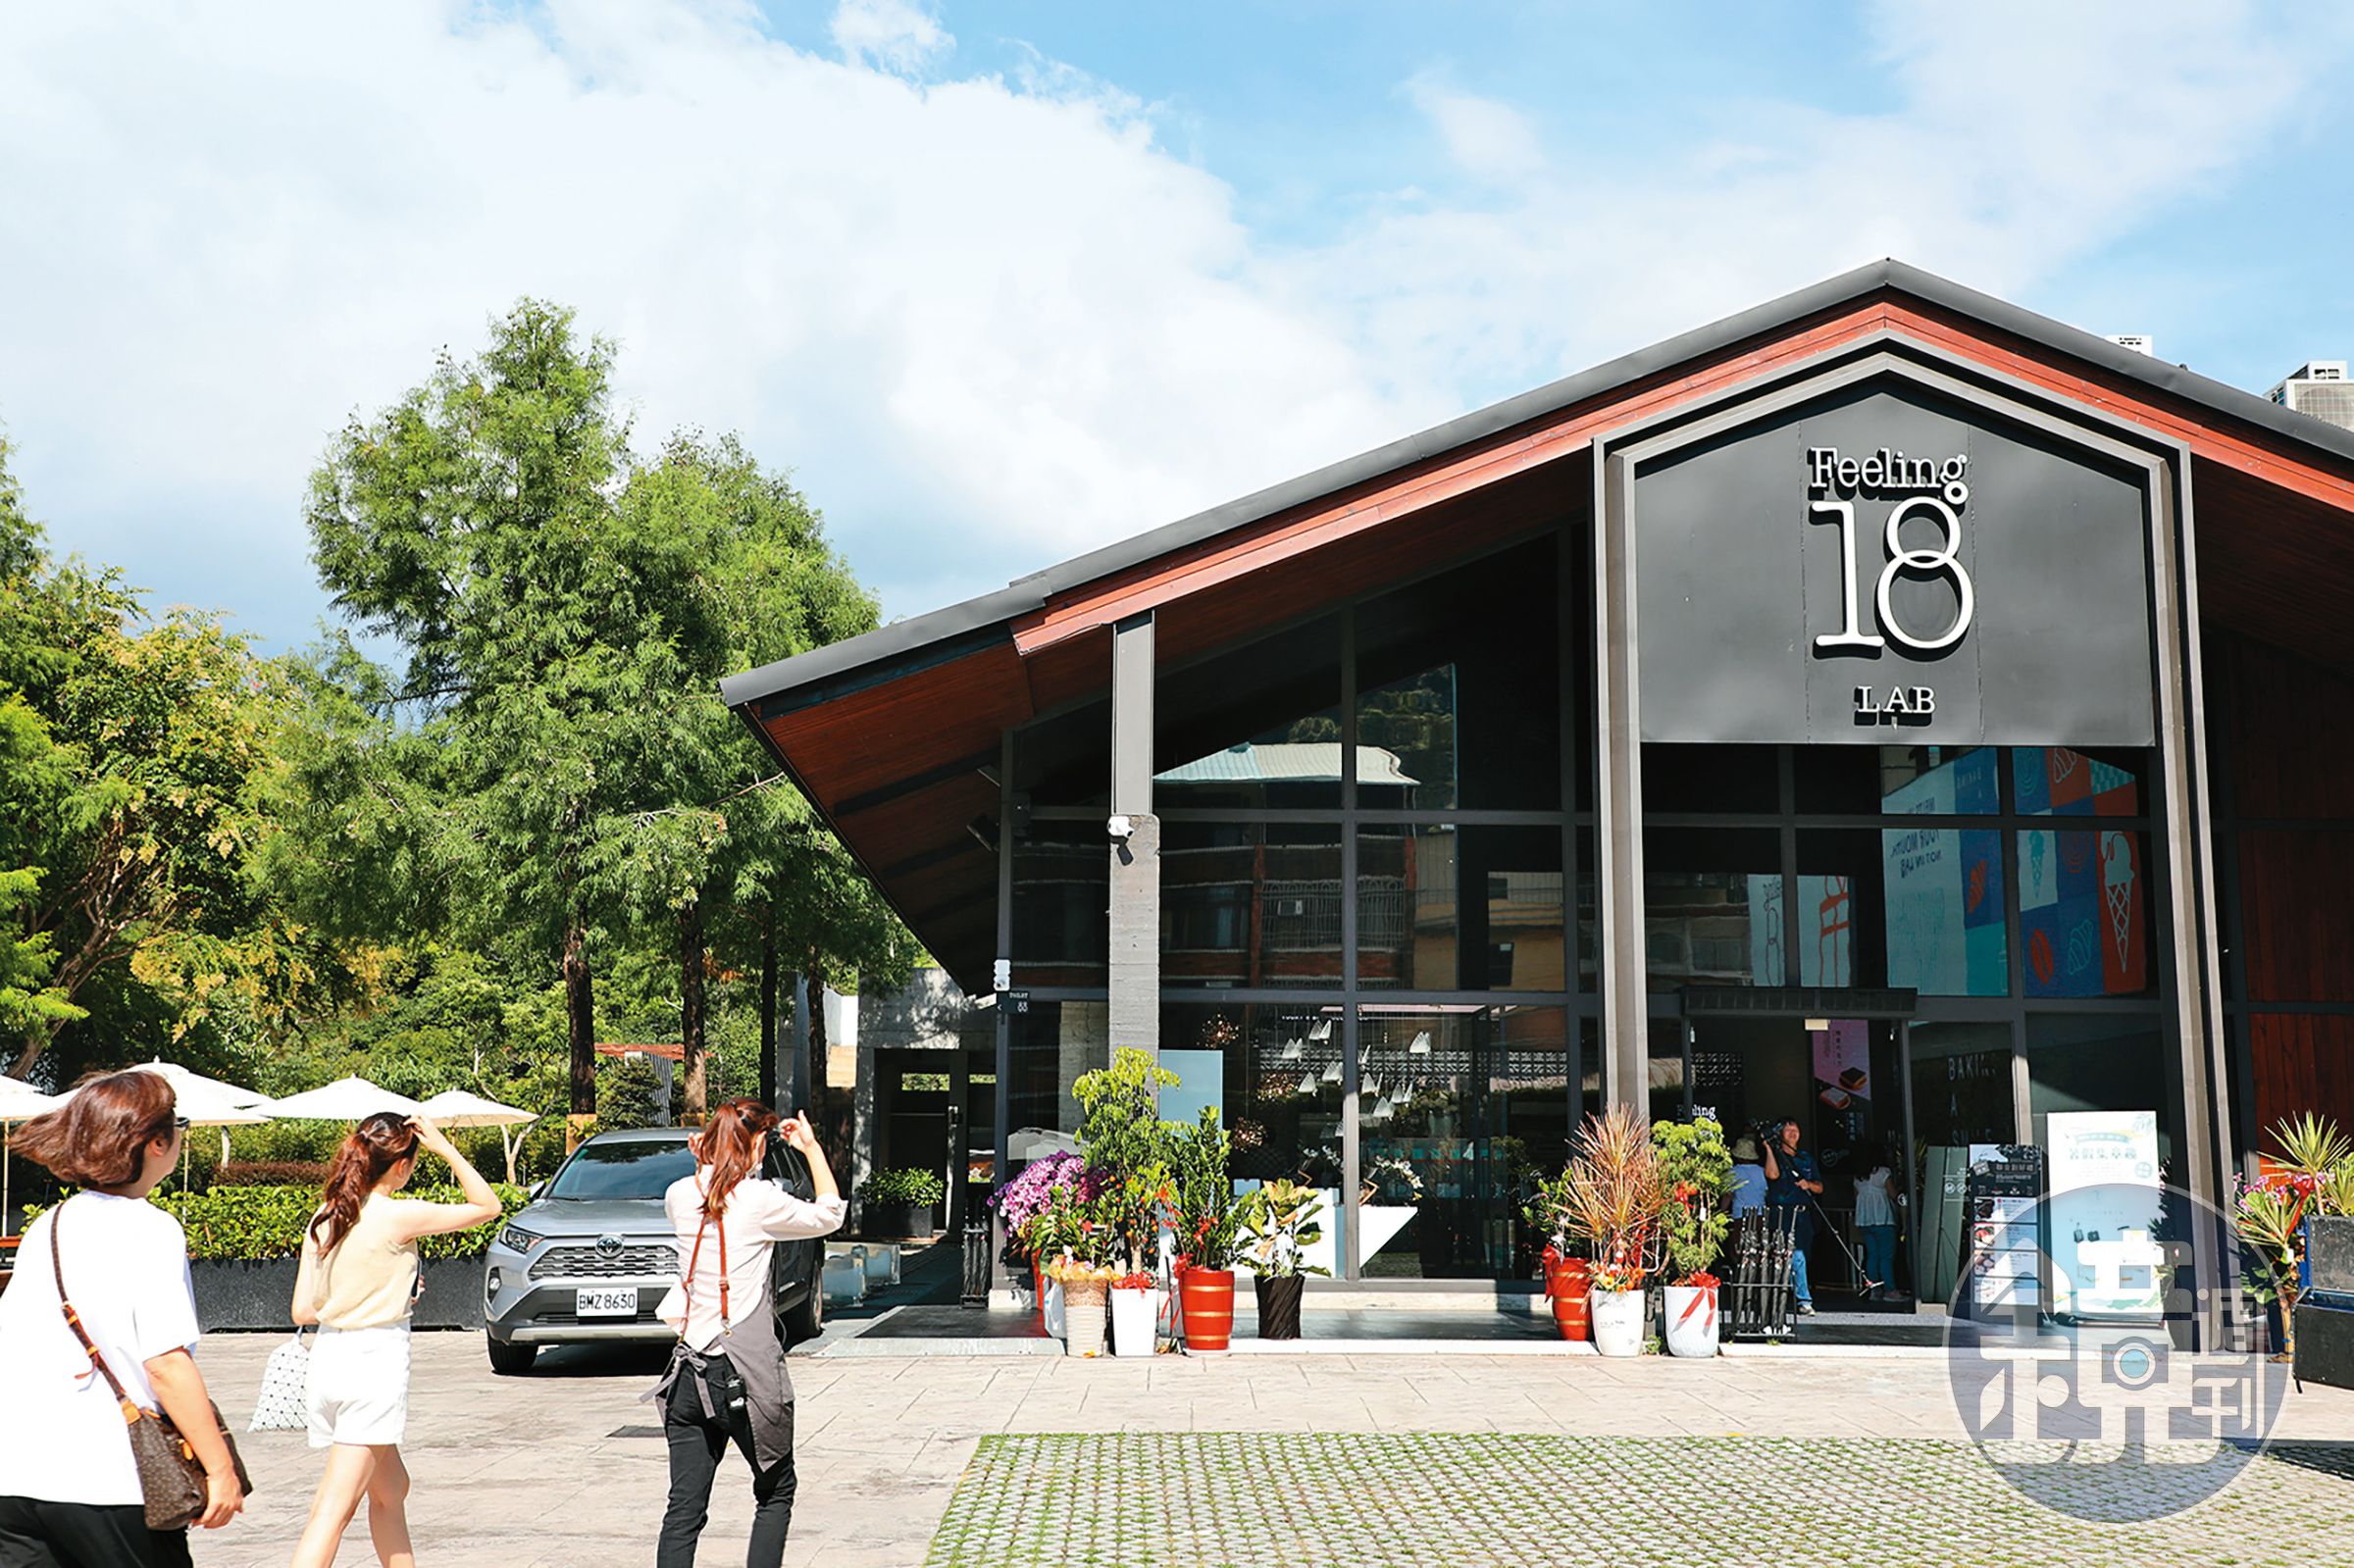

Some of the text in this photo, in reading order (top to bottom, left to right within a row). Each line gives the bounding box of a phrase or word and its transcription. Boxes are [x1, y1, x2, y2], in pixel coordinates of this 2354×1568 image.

[1810, 446, 1969, 504] Feeling
[1812, 496, 1973, 649] 18
[1857, 685, 1936, 715] LAB
